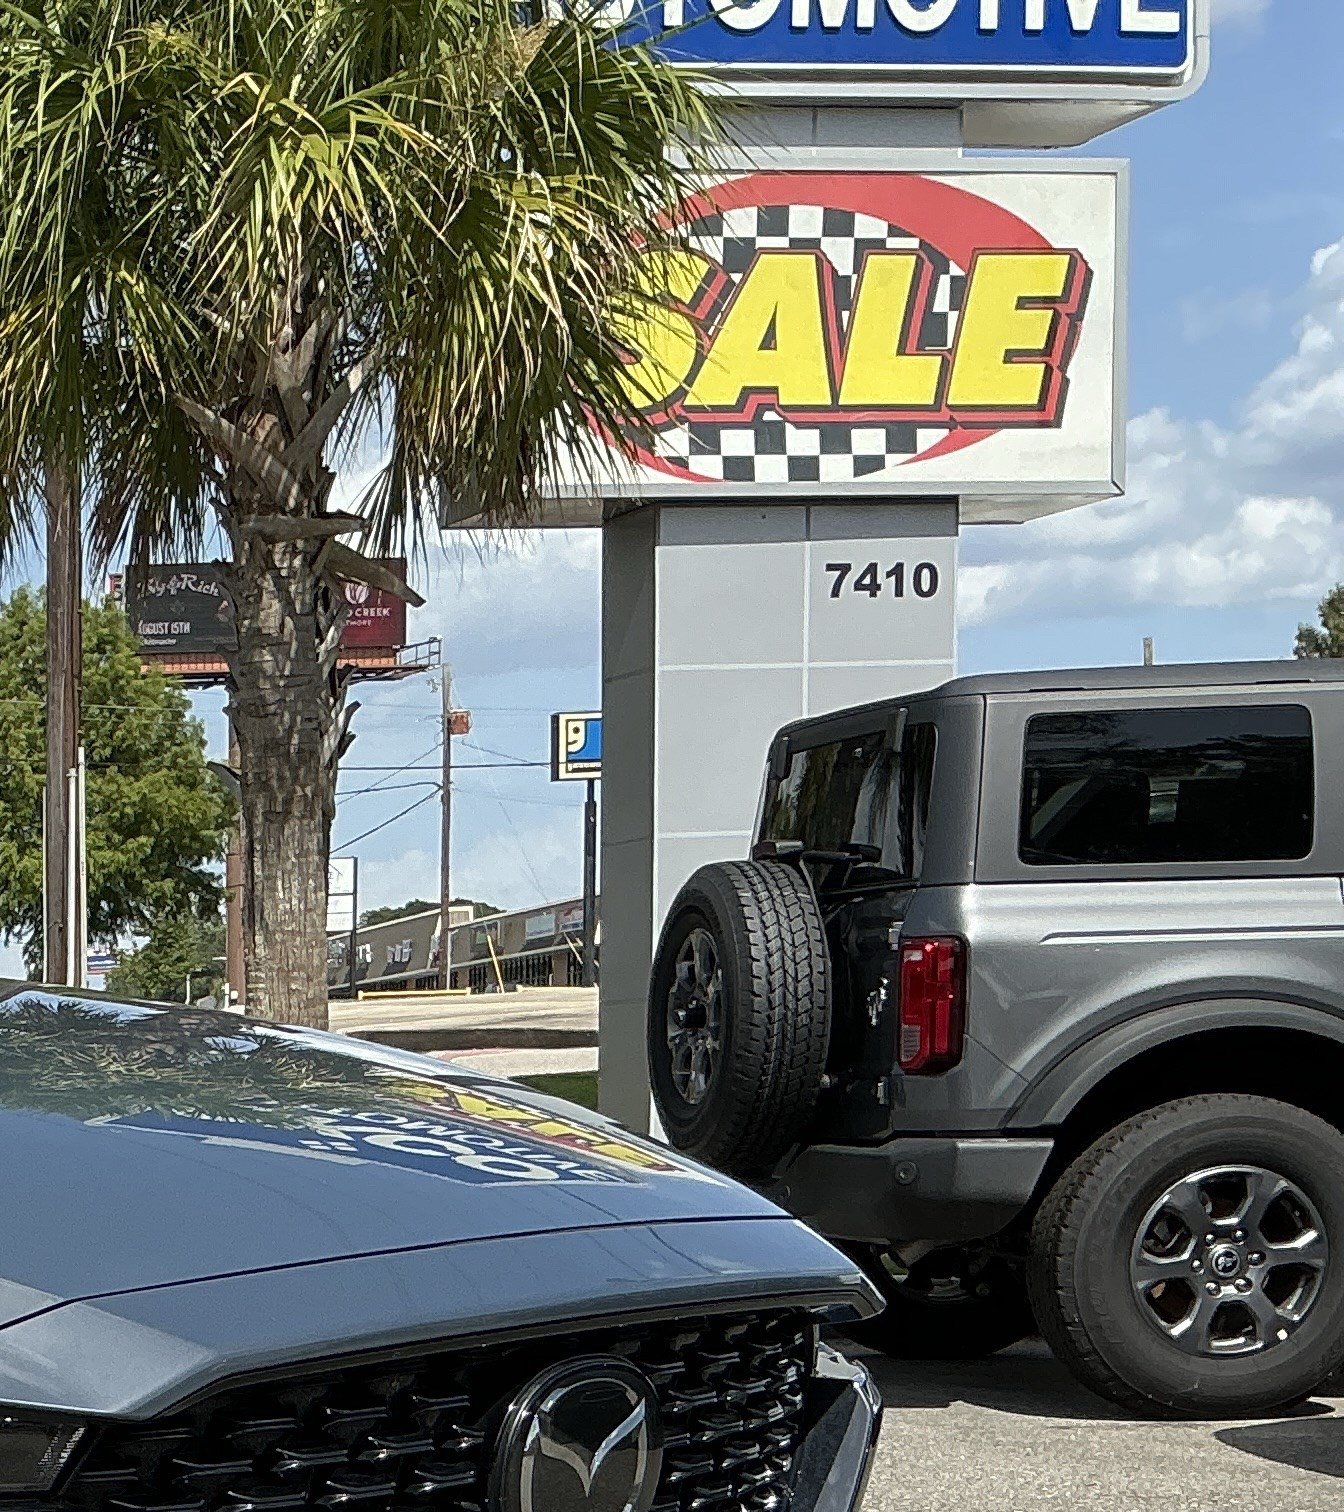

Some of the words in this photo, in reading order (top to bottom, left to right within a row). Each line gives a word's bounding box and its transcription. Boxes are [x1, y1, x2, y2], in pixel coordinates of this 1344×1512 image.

[605, 248, 1088, 422] SALE
[825, 562, 939, 599] 7410
[355, 607, 391, 617] CREEK
